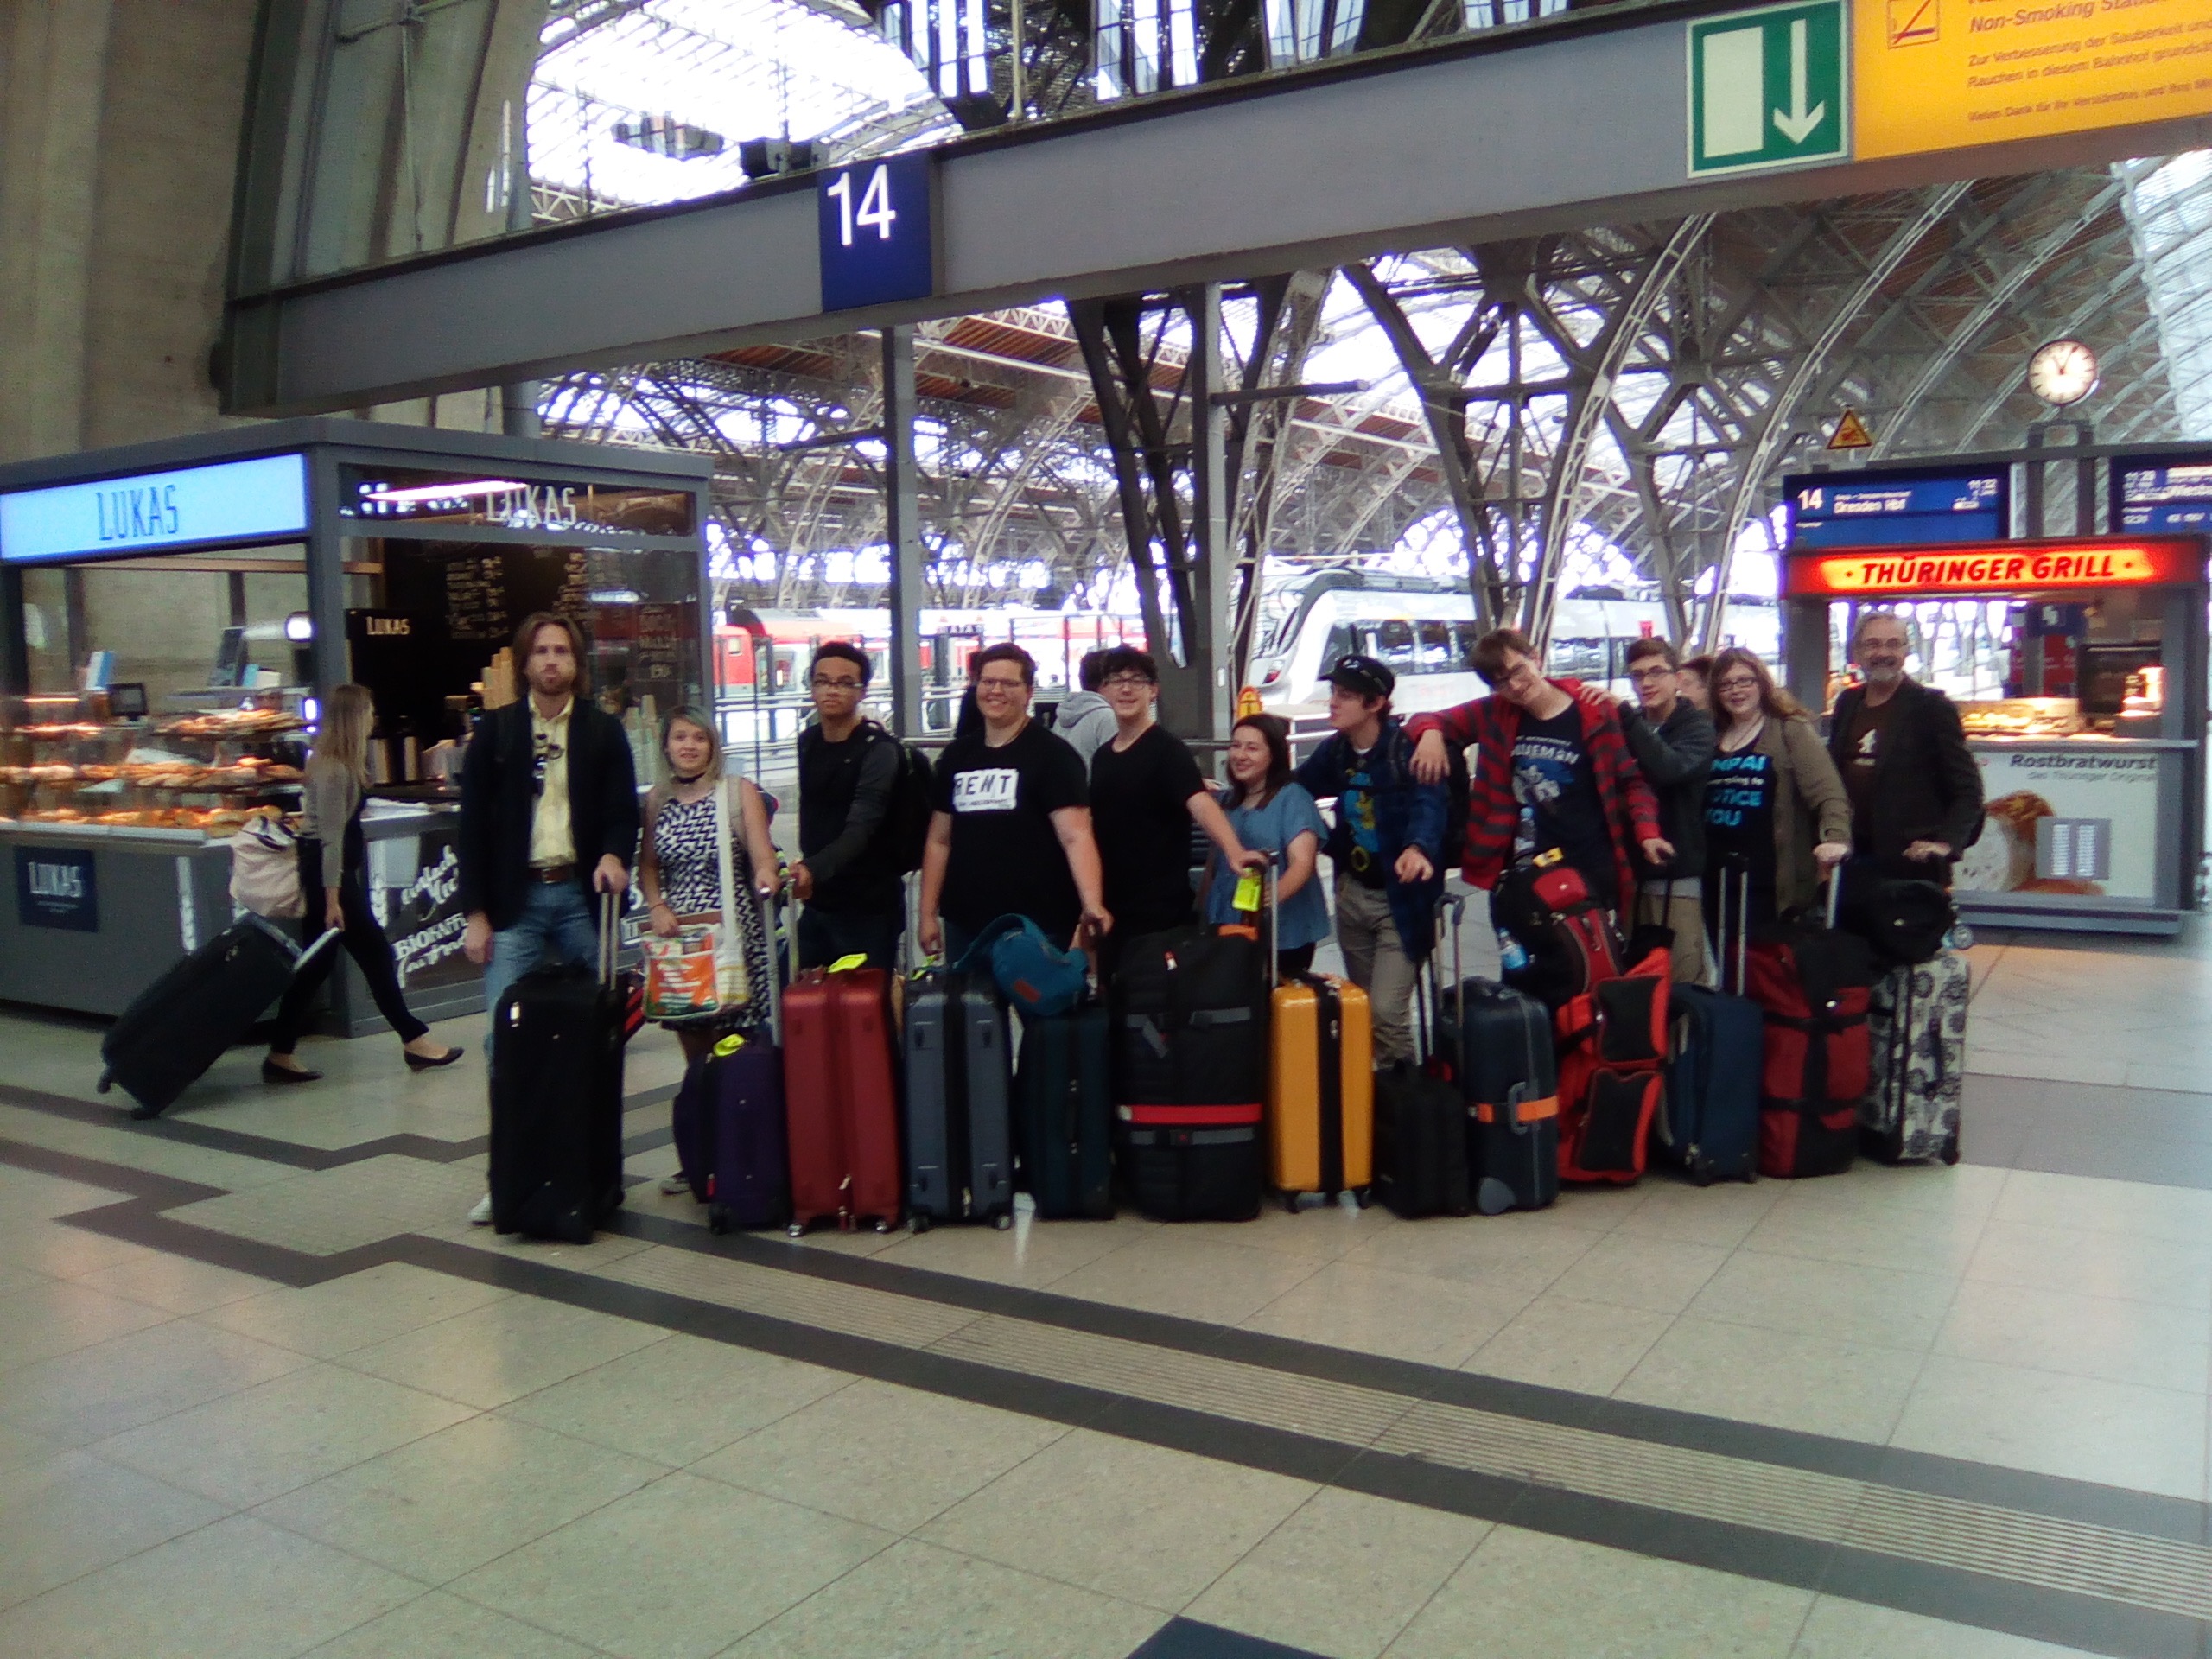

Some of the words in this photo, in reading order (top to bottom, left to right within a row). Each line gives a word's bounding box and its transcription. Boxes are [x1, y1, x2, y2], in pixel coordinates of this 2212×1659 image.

[1969, 2, 2094, 33] Non-Smoking
[827, 164, 896, 245] 14
[95, 484, 179, 541] LUKAS
[486, 484, 577, 527] LUKAS
[1798, 488, 1823, 511] 14
[1863, 555, 2025, 585] THÜRINGER
[2031, 554, 2114, 579] GRILL
[365, 616, 410, 636] LUKAS
[2010, 753, 2157, 769] Rostbratwurst
